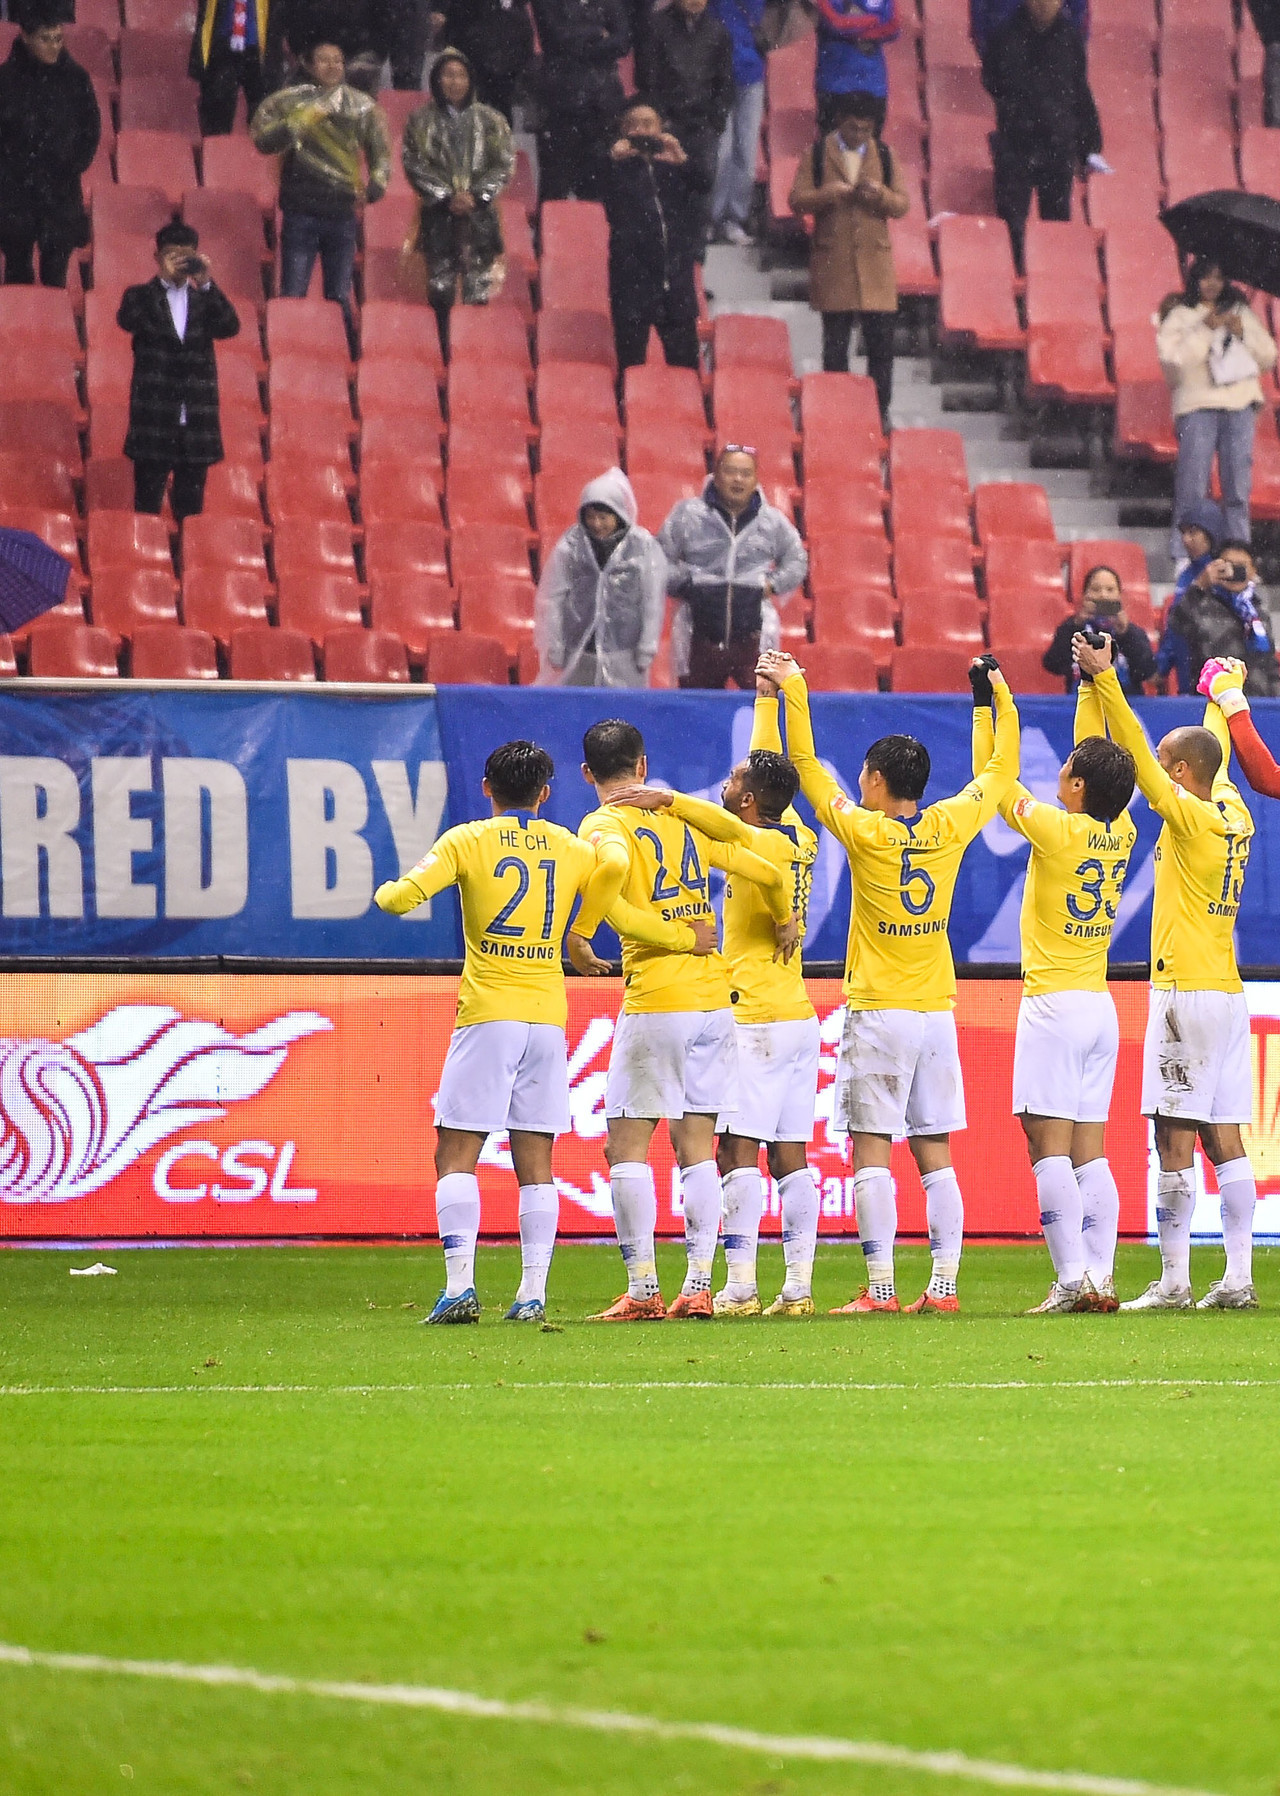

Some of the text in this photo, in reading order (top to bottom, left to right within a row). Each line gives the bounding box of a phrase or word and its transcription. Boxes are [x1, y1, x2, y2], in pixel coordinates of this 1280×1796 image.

[287, 758, 448, 920] BY
[499, 829, 552, 851] HE CH.
[634, 823, 707, 903] 24
[1088, 831, 1123, 852] WANG
[485, 855, 557, 941] 21
[901, 847, 935, 916] 5
[1066, 858, 1127, 922] 33
[480, 940, 555, 960] SAMSUNG
[153, 1140, 318, 1203] CSL
